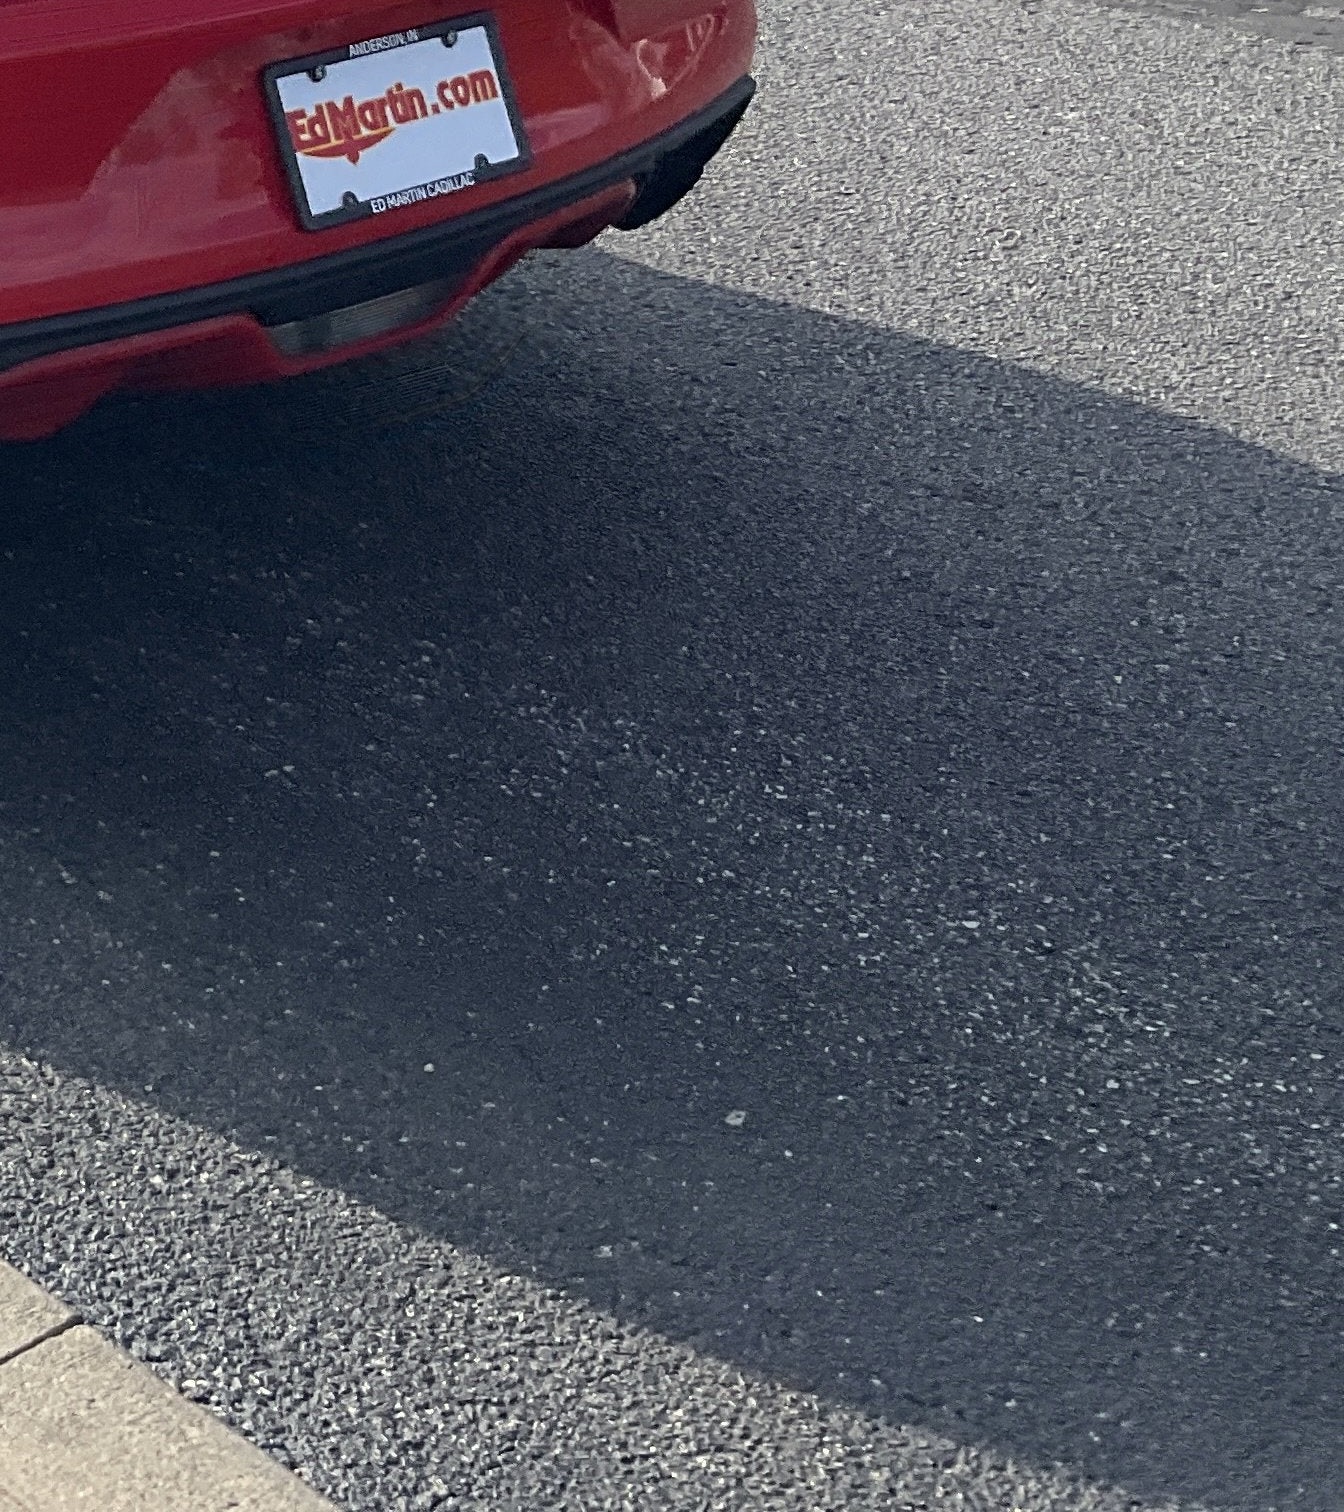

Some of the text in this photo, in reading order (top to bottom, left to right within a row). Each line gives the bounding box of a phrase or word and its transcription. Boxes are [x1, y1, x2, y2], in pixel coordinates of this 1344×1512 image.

[285, 68, 499, 146] EdMartin.com
[371, 173, 476, 213] ED MARTIN CADILLAC
